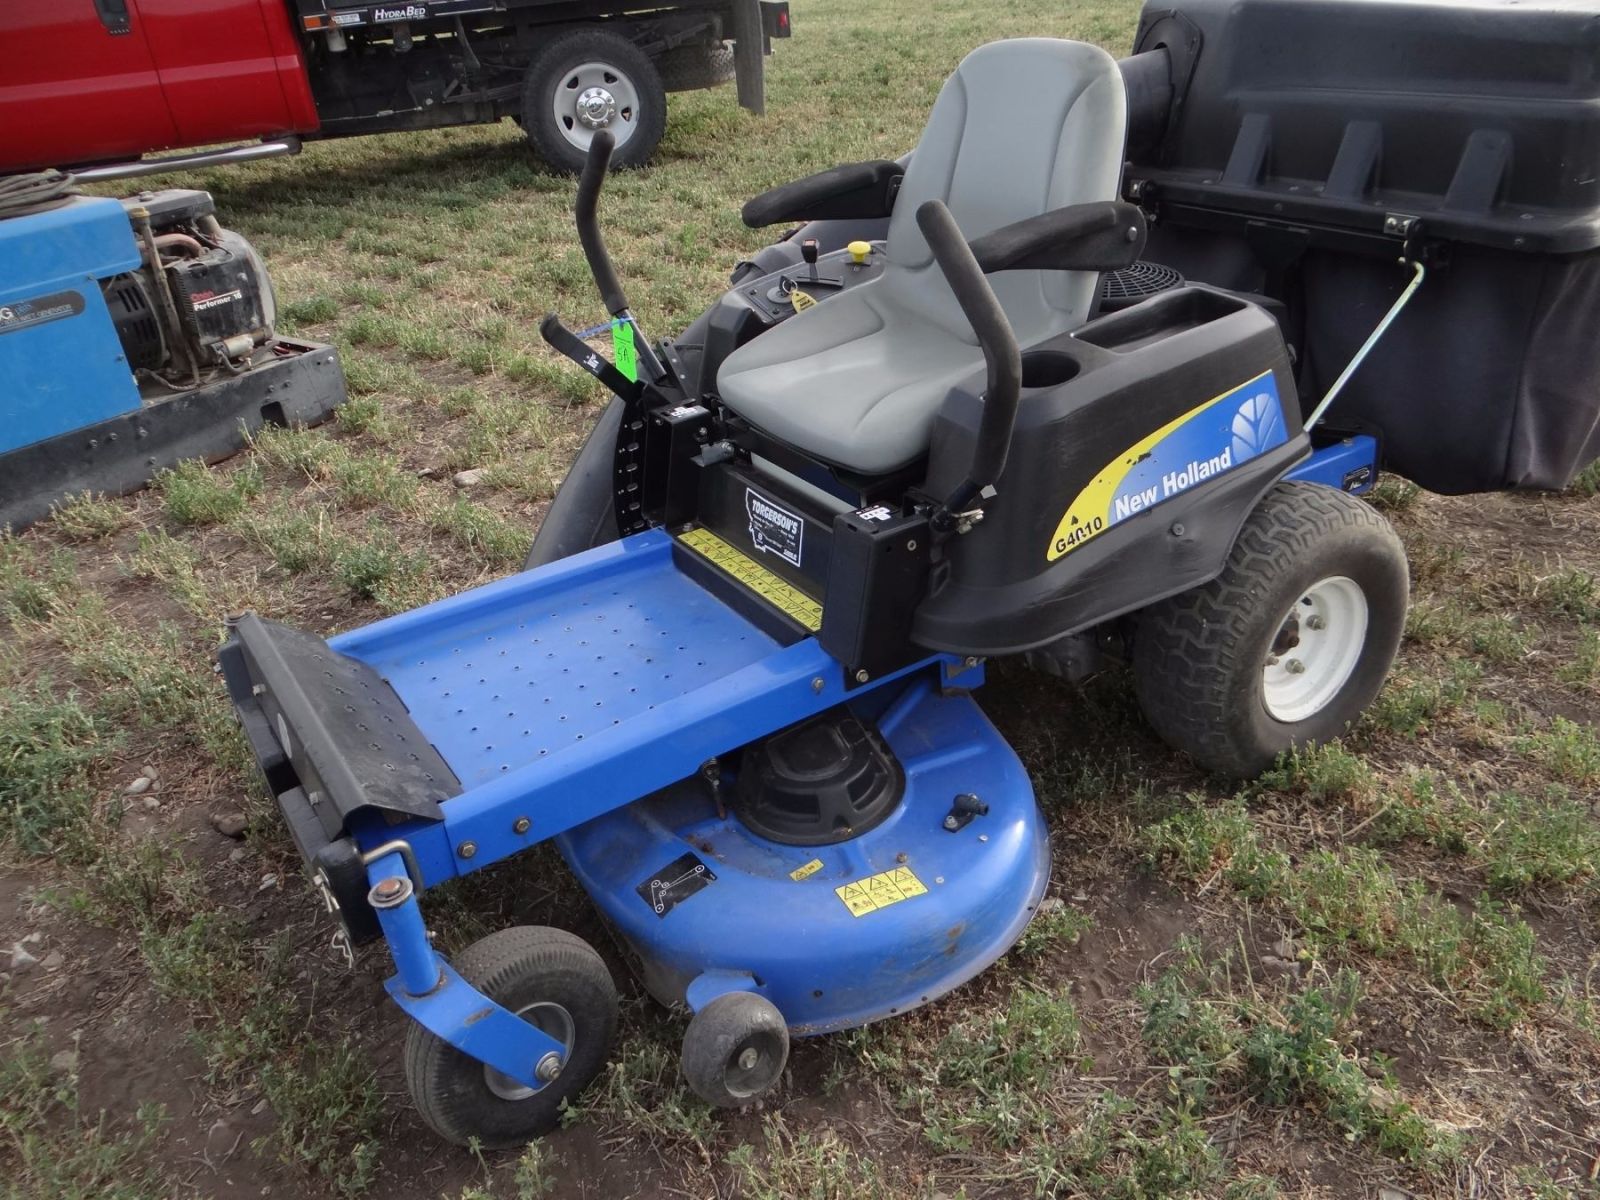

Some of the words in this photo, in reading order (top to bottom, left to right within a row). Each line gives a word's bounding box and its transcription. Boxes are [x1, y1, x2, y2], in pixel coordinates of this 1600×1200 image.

[193, 296, 231, 311] Performer
[1114, 483, 1159, 520] New
[1162, 446, 1232, 497] Holland
[752, 499, 798, 535] TORGERSON'S
